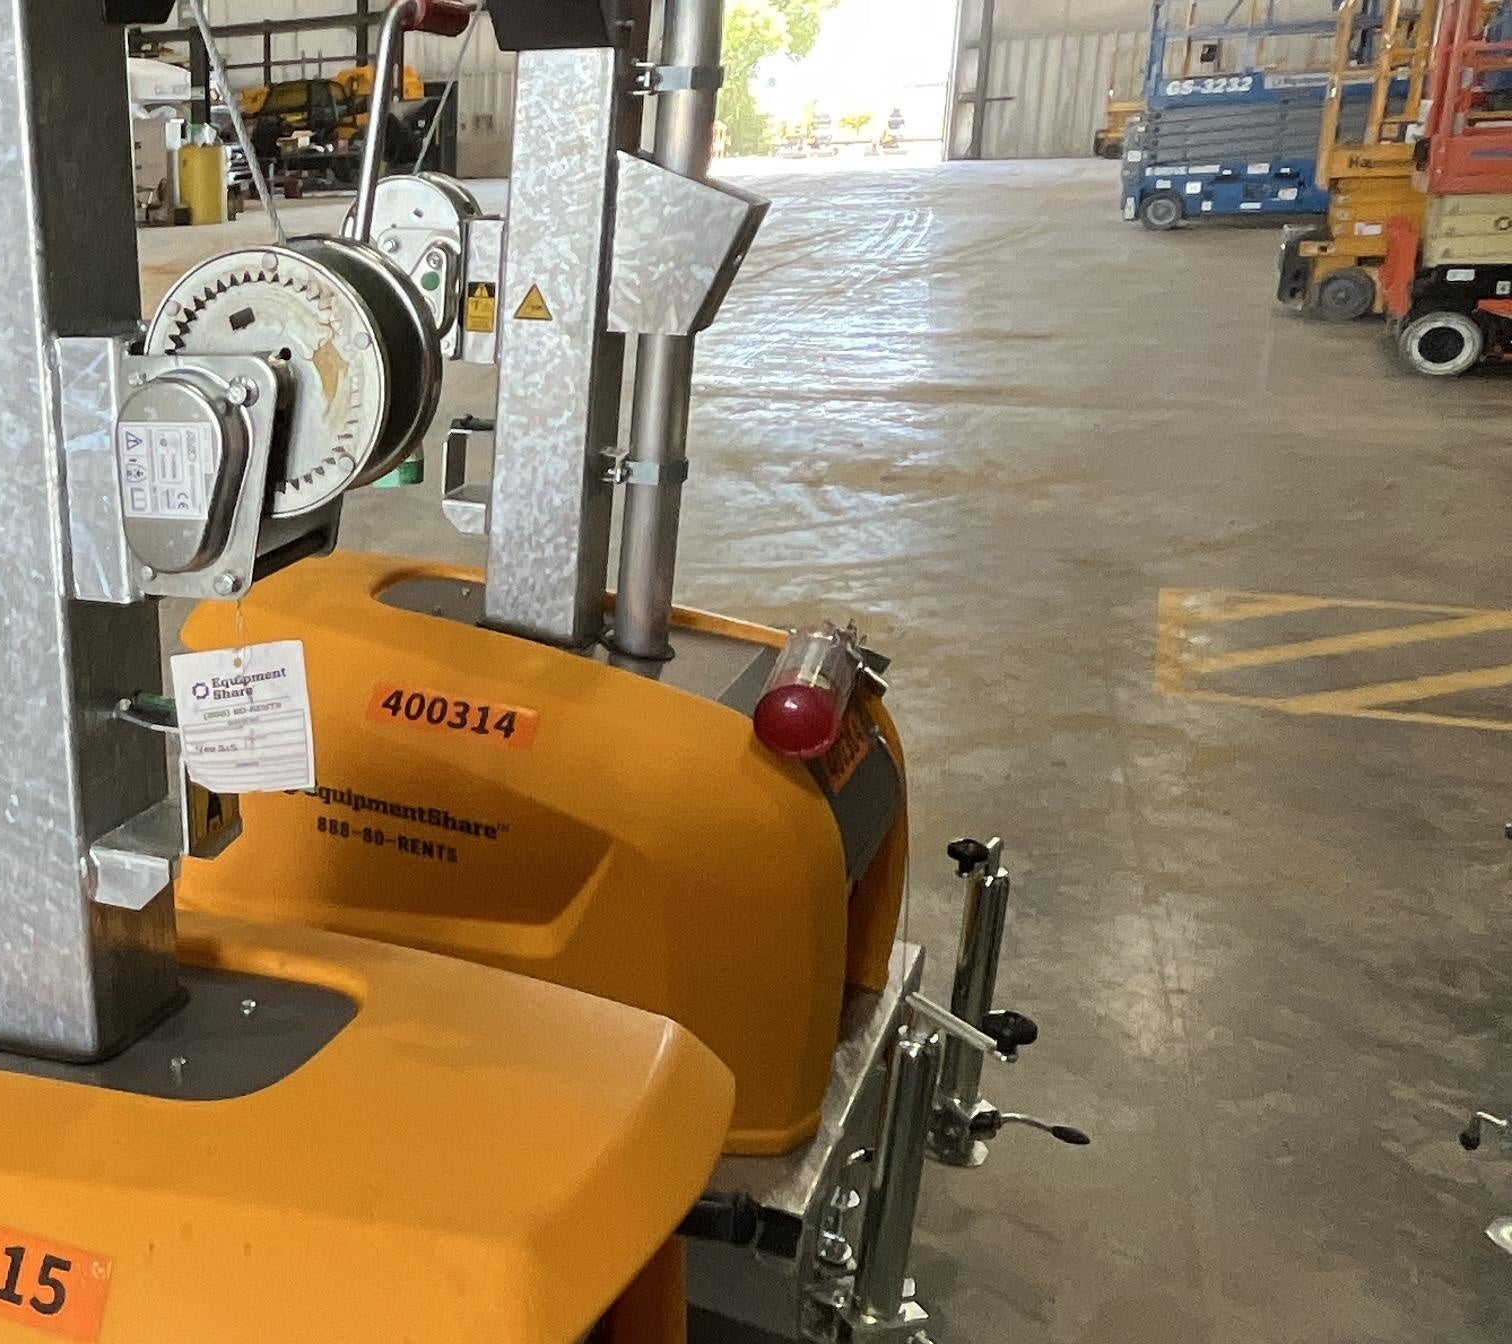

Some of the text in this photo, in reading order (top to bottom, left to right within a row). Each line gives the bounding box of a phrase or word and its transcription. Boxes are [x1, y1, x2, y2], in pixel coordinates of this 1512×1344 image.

[1165, 76, 1253, 96] GS-3232
[211, 666, 287, 689] Equipment
[212, 685, 253, 700] Share
[381, 688, 518, 739] 400314
[316, 816, 459, 864] 888-80-RENTS
